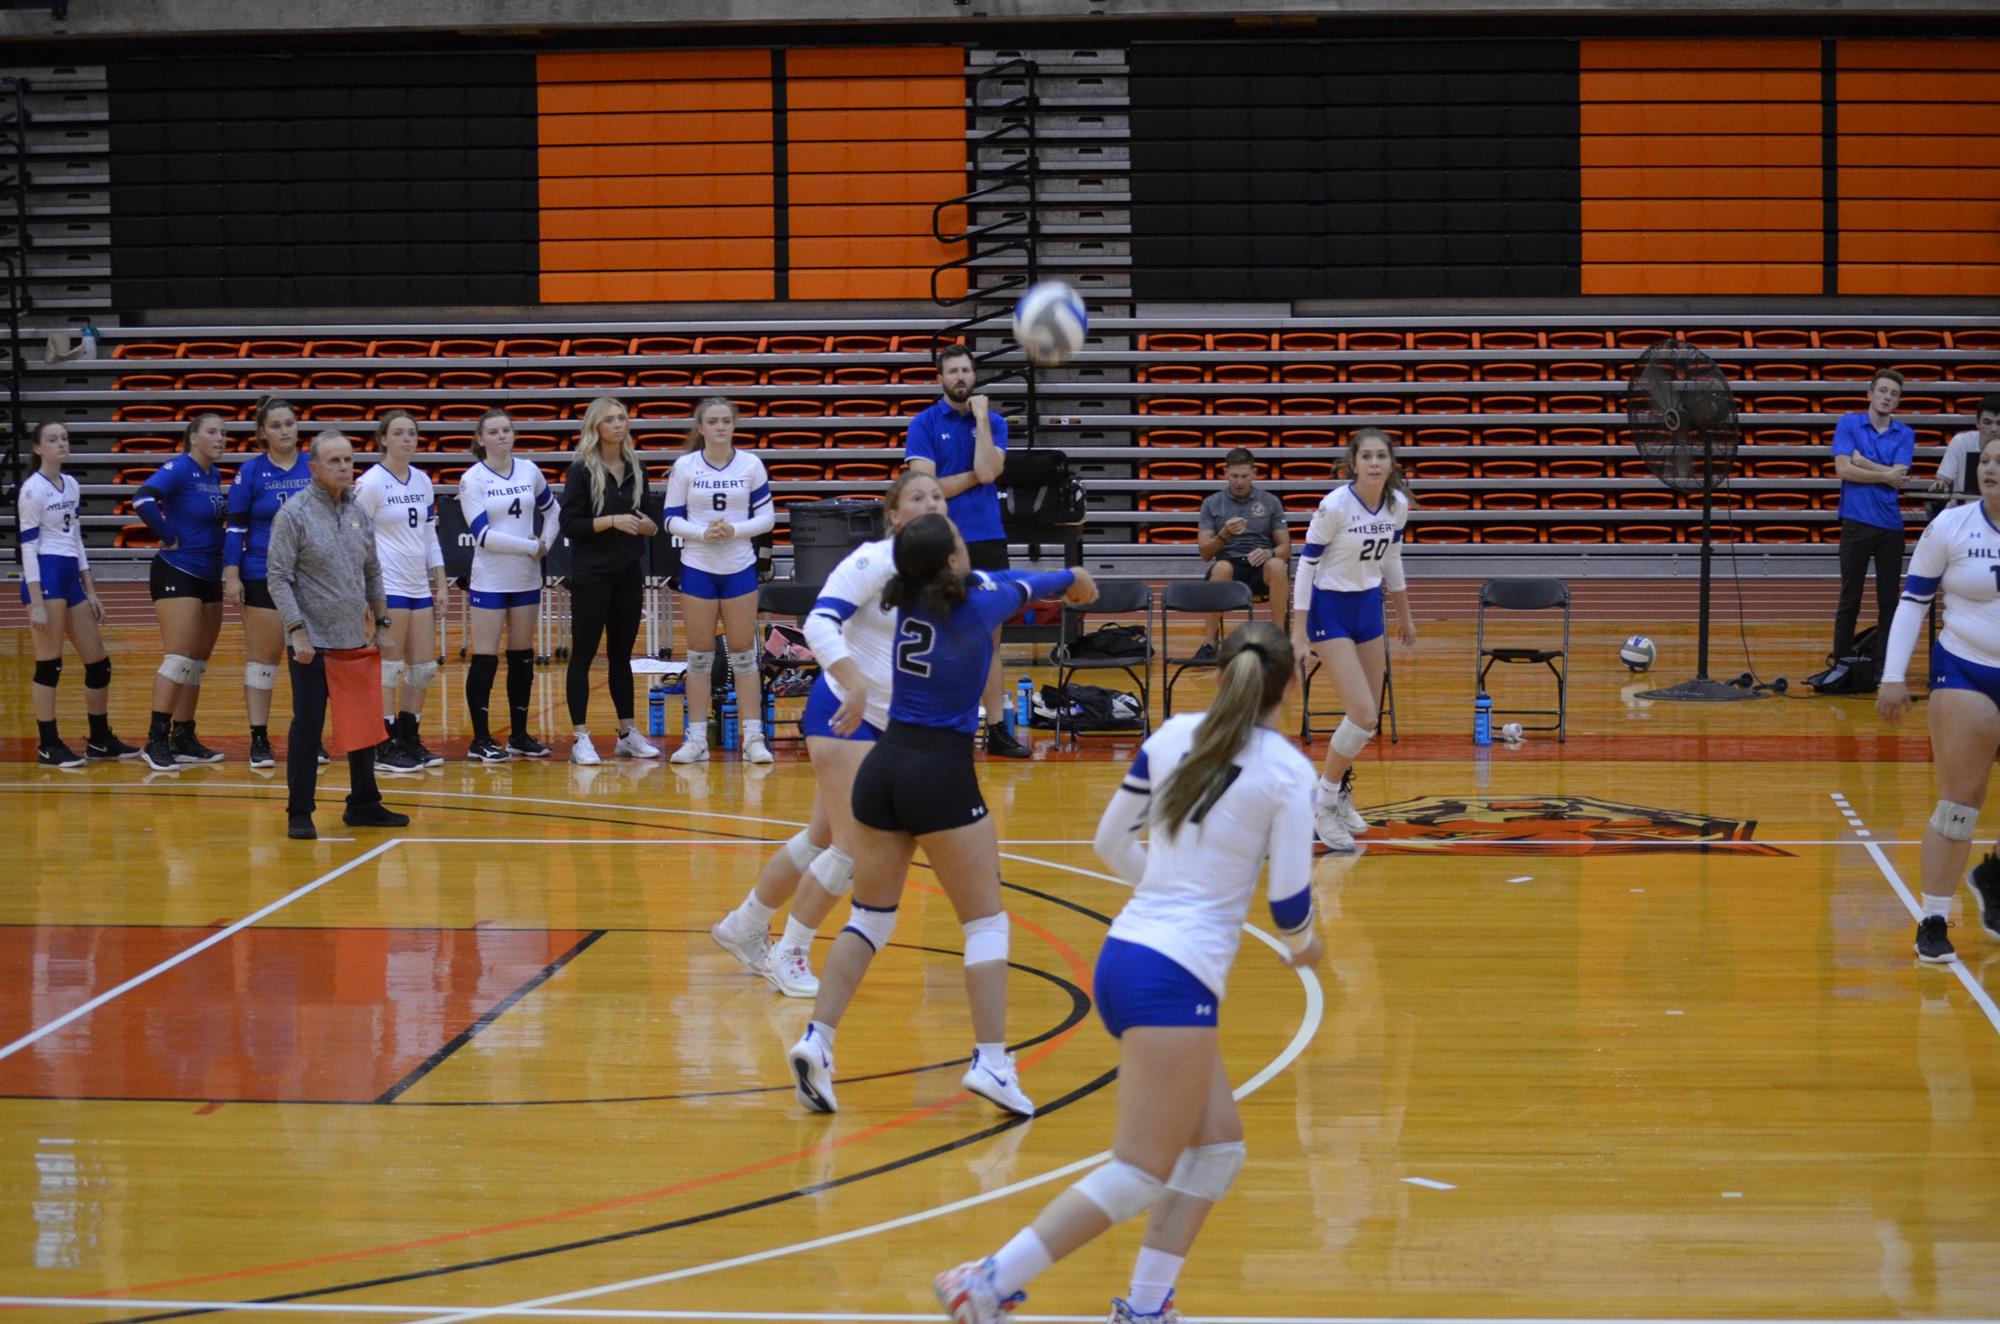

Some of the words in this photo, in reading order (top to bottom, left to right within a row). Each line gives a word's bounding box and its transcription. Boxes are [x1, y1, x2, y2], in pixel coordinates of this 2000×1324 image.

[487, 485, 532, 497] HILBERT
[692, 480, 745, 489] HILBERT
[387, 494, 425, 505] HILBERT
[508, 498, 522, 519] 4
[712, 493, 727, 511] 6
[62, 513, 71, 533] 3
[408, 507, 418, 528] 8
[1360, 538, 1390, 561] 20
[1968, 548, 2000, 558] HIL
[897, 616, 936, 678] 2
